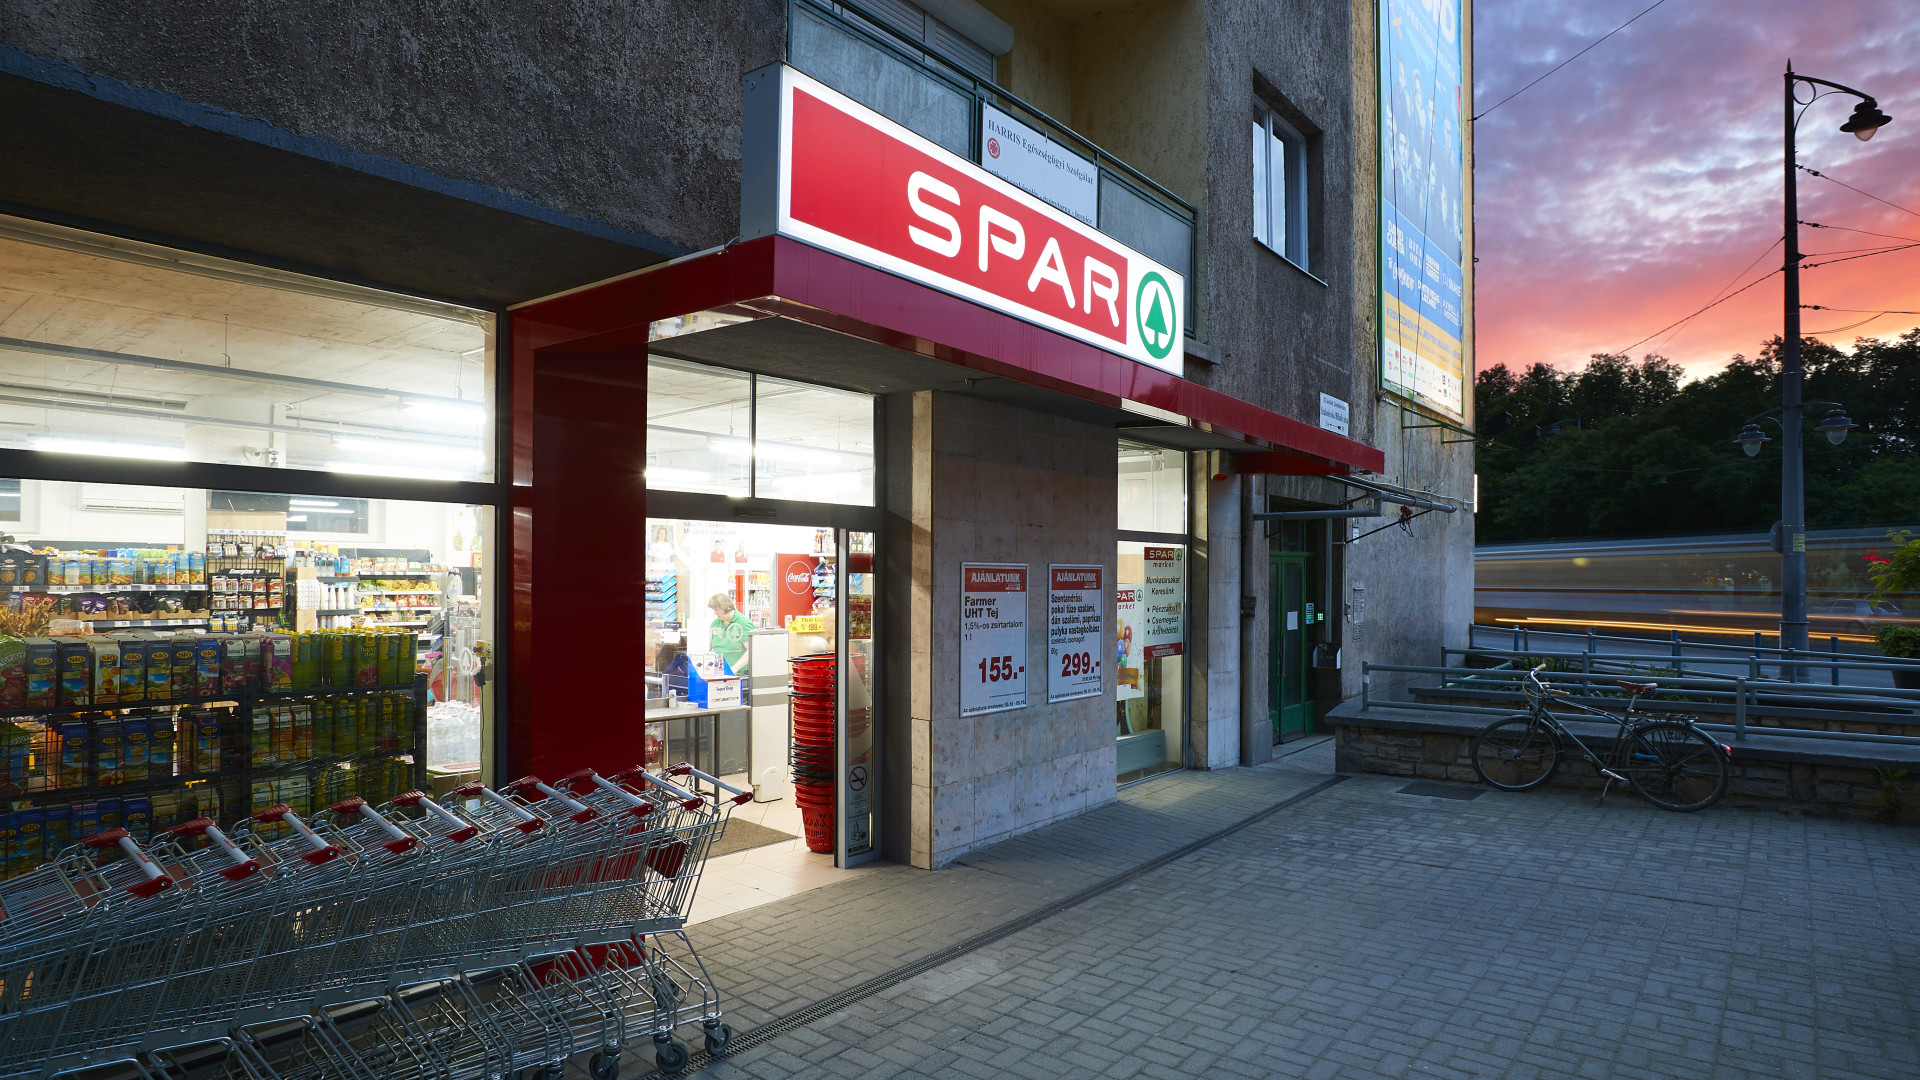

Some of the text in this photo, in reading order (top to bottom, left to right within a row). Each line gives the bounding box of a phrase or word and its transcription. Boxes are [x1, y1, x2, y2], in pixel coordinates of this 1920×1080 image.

[988, 119, 1094, 186] HARRIS Egészségügyi Szolgálat
[908, 170, 1120, 328] SPAR
[1149, 550, 1174, 559] SPAR
[971, 570, 1021, 583] AJÁNLATUNK
[1056, 570, 1097, 582] AJÁNLATUNK
[964, 595, 997, 606] Farmer
[1117, 591, 1135, 601] PAR
[1117, 602, 1135, 610] arket
[964, 607, 999, 620] UHT Tej
[964, 621, 990, 631] 1,5%-os
[978, 655, 1025, 684] 155.-
[1061, 651, 1100, 678] 299.-
